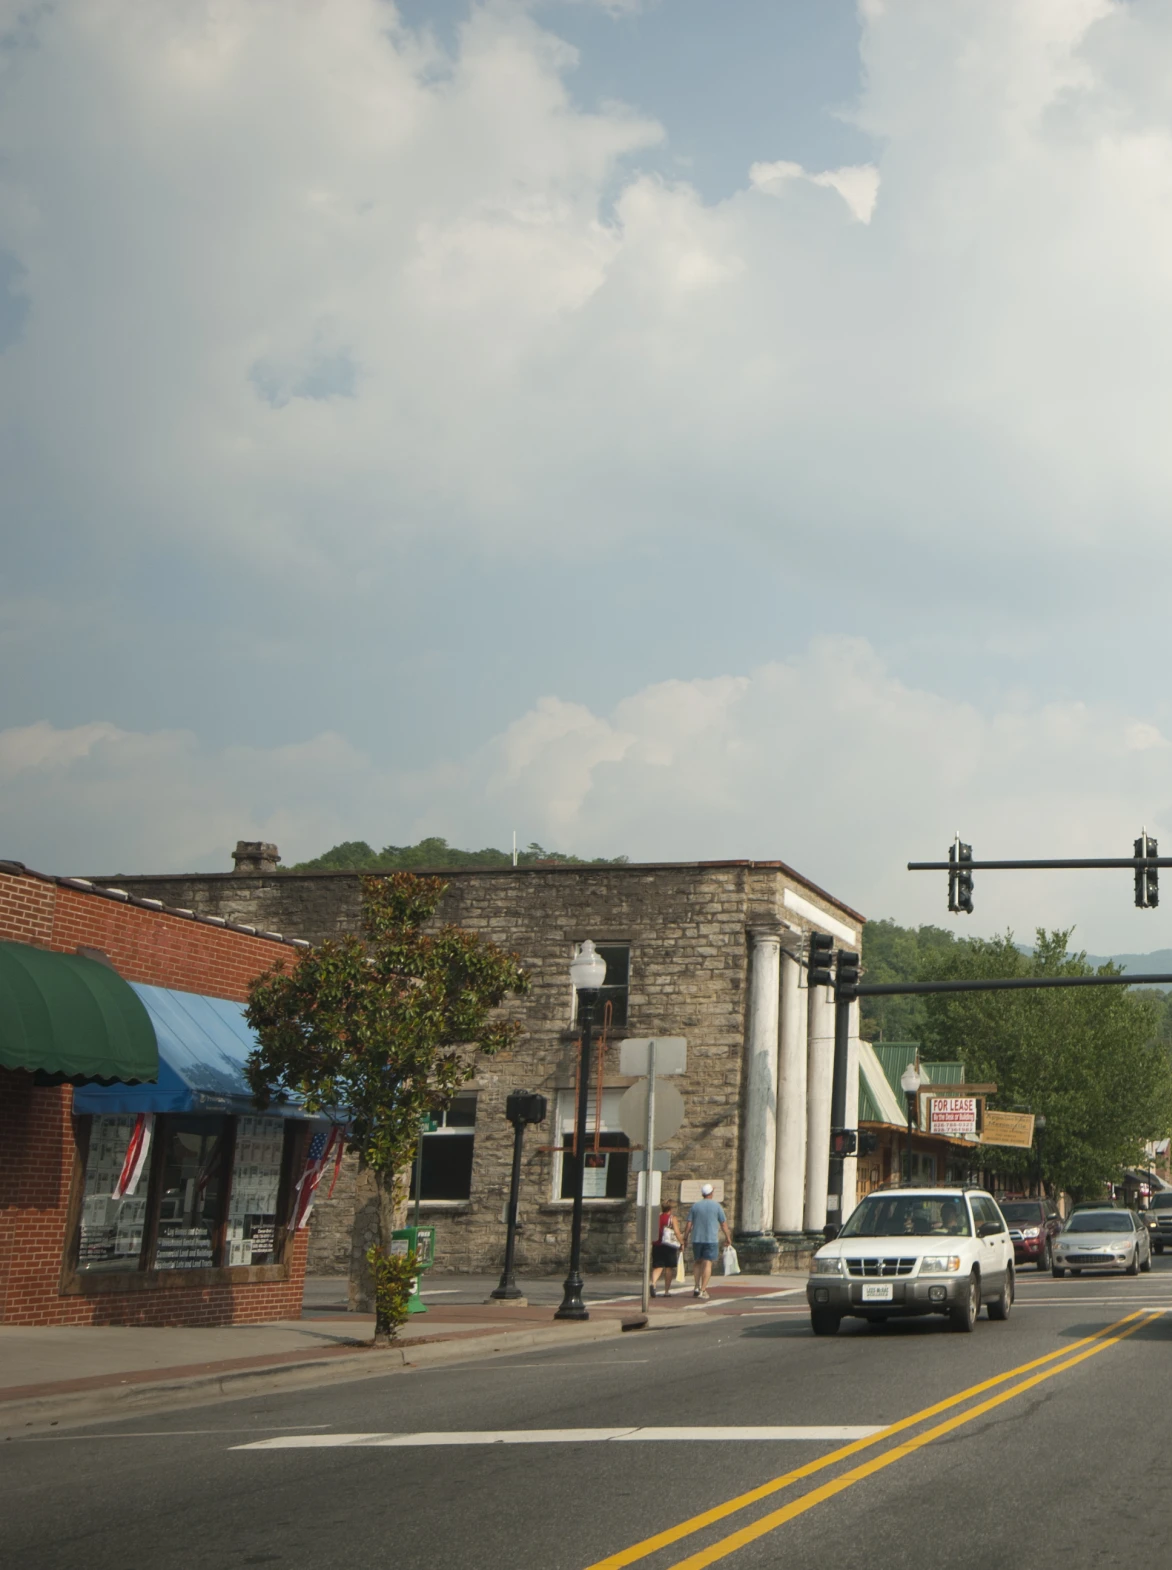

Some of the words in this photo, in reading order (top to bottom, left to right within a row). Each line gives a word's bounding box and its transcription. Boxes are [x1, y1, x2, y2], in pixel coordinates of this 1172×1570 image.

[934, 1100, 948, 1110] FOR
[950, 1100, 973, 1110] LEASE
[180, 1249, 189, 1257] Land
